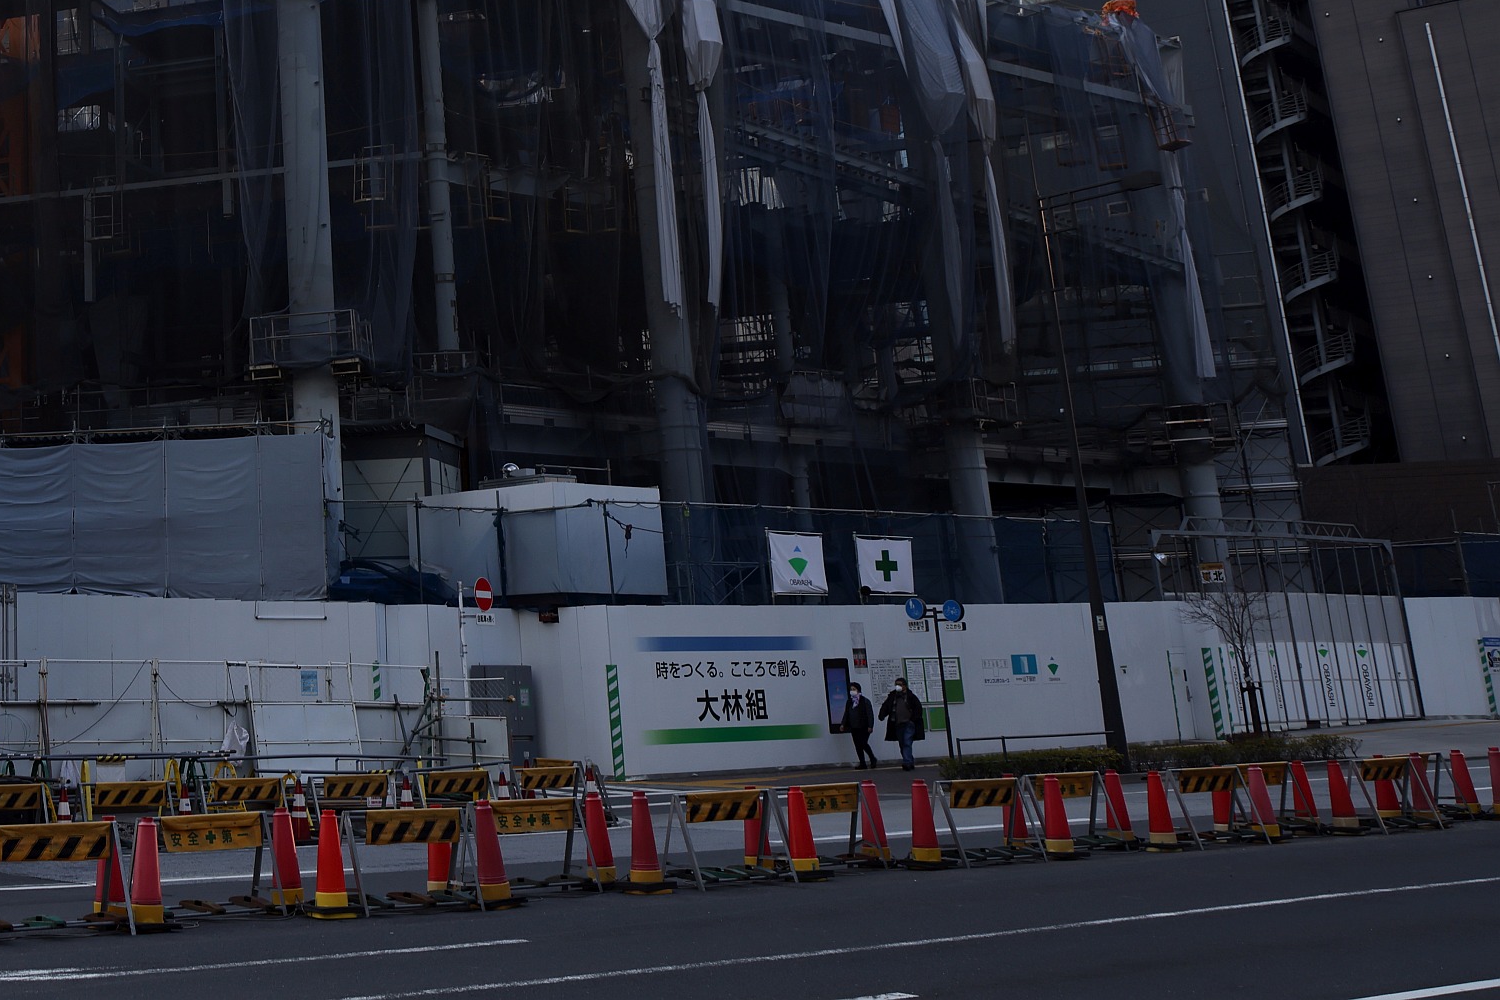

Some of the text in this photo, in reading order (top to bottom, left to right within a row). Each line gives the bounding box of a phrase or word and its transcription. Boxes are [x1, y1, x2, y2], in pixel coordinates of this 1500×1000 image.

[1322, 663, 1336, 707] OBAYASHI
[1361, 663, 1375, 707] OBAYASHI
[696, 688, 769, 722] 大林組
[170, 828, 249, 847] 安全 第一
[497, 812, 563, 829] 安全 第一
